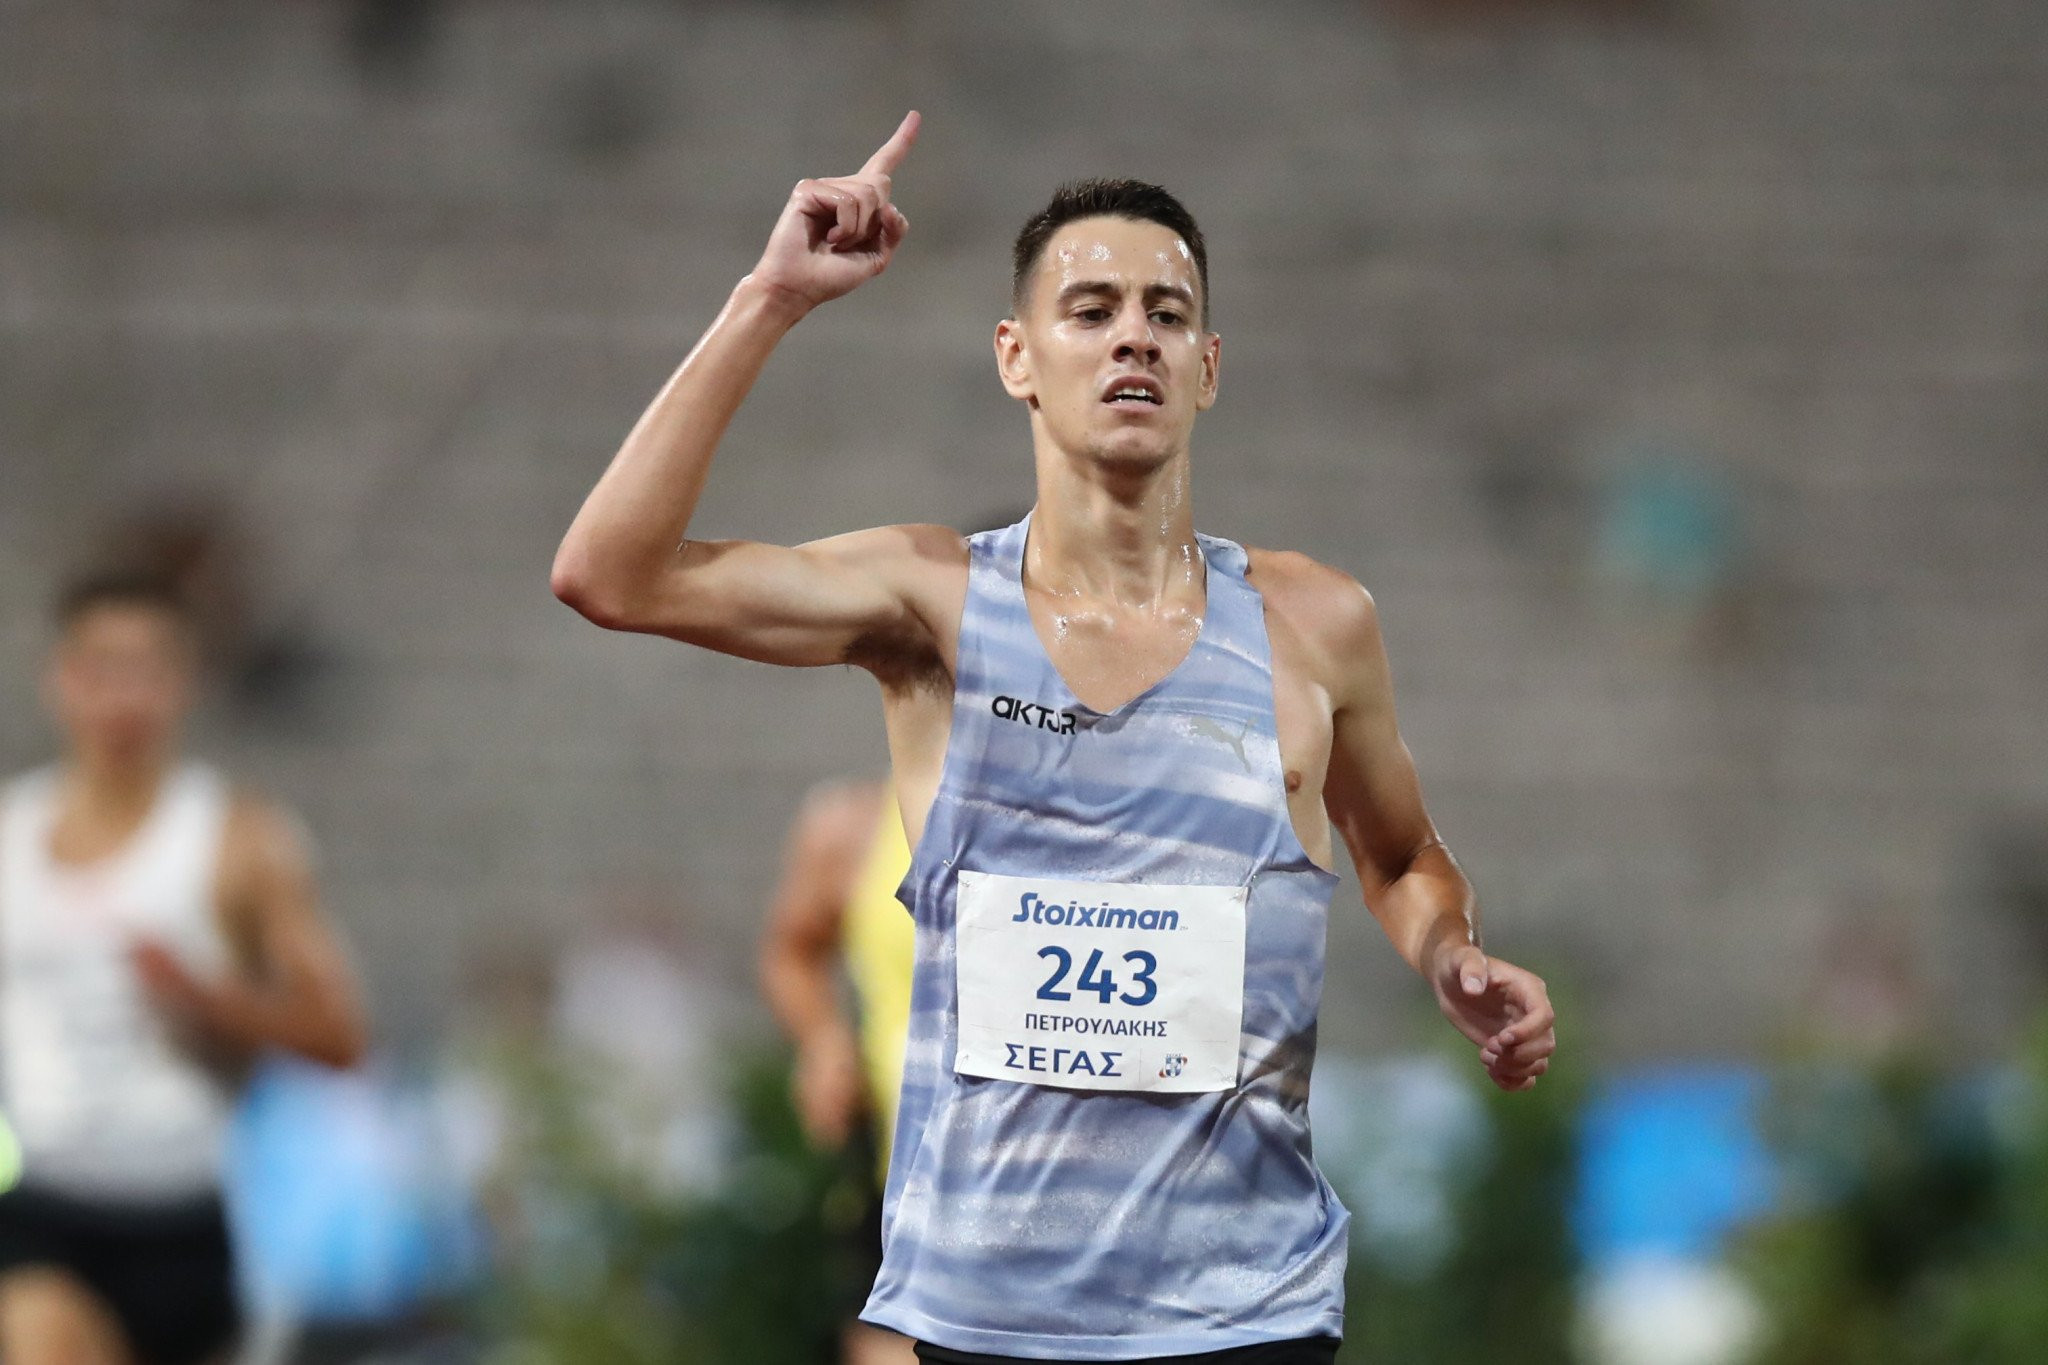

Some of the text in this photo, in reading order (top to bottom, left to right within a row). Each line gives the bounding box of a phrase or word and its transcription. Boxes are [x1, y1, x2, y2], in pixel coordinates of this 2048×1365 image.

[1012, 891, 1179, 930] Stoiximan
[1036, 945, 1158, 1006] 243
[1025, 1013, 1168, 1037] ΠΕΤΡΟΥΛΑΚΗΣ
[1004, 1042, 1123, 1077] ΣΕΓΑΣ
